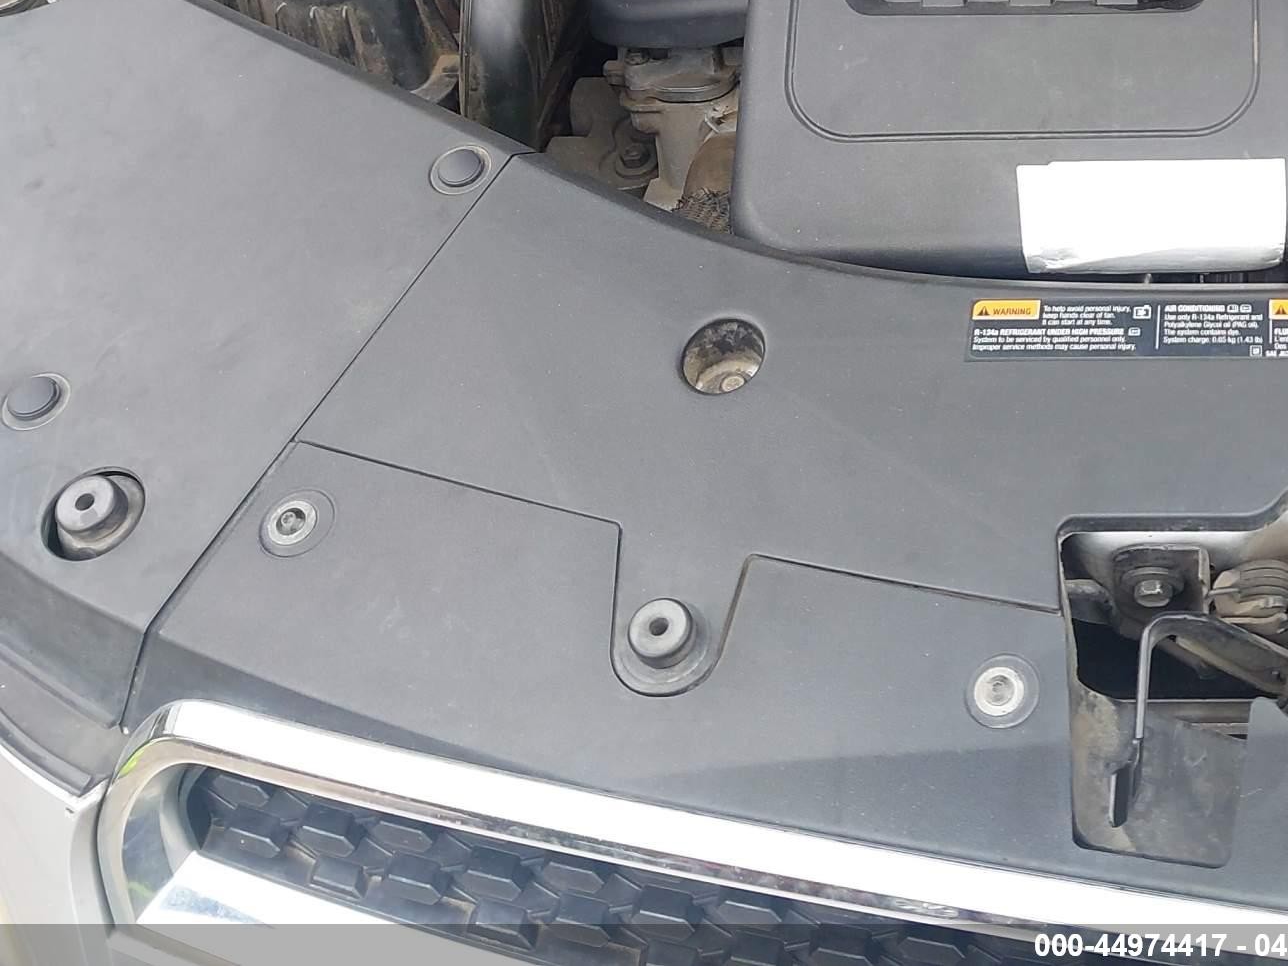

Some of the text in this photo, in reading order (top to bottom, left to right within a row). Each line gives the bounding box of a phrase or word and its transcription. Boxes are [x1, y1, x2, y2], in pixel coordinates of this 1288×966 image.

[993, 307, 1031, 315] WARNING
[1052, 305, 1066, 313] help
[1067, 305, 1084, 313] avoid
[1085, 305, 1111, 313] personal
[974, 328, 1124, 336] R-134a REFRIGERANT UNDER HIGH PRESSURE
[1163, 336, 1186, 344] System
